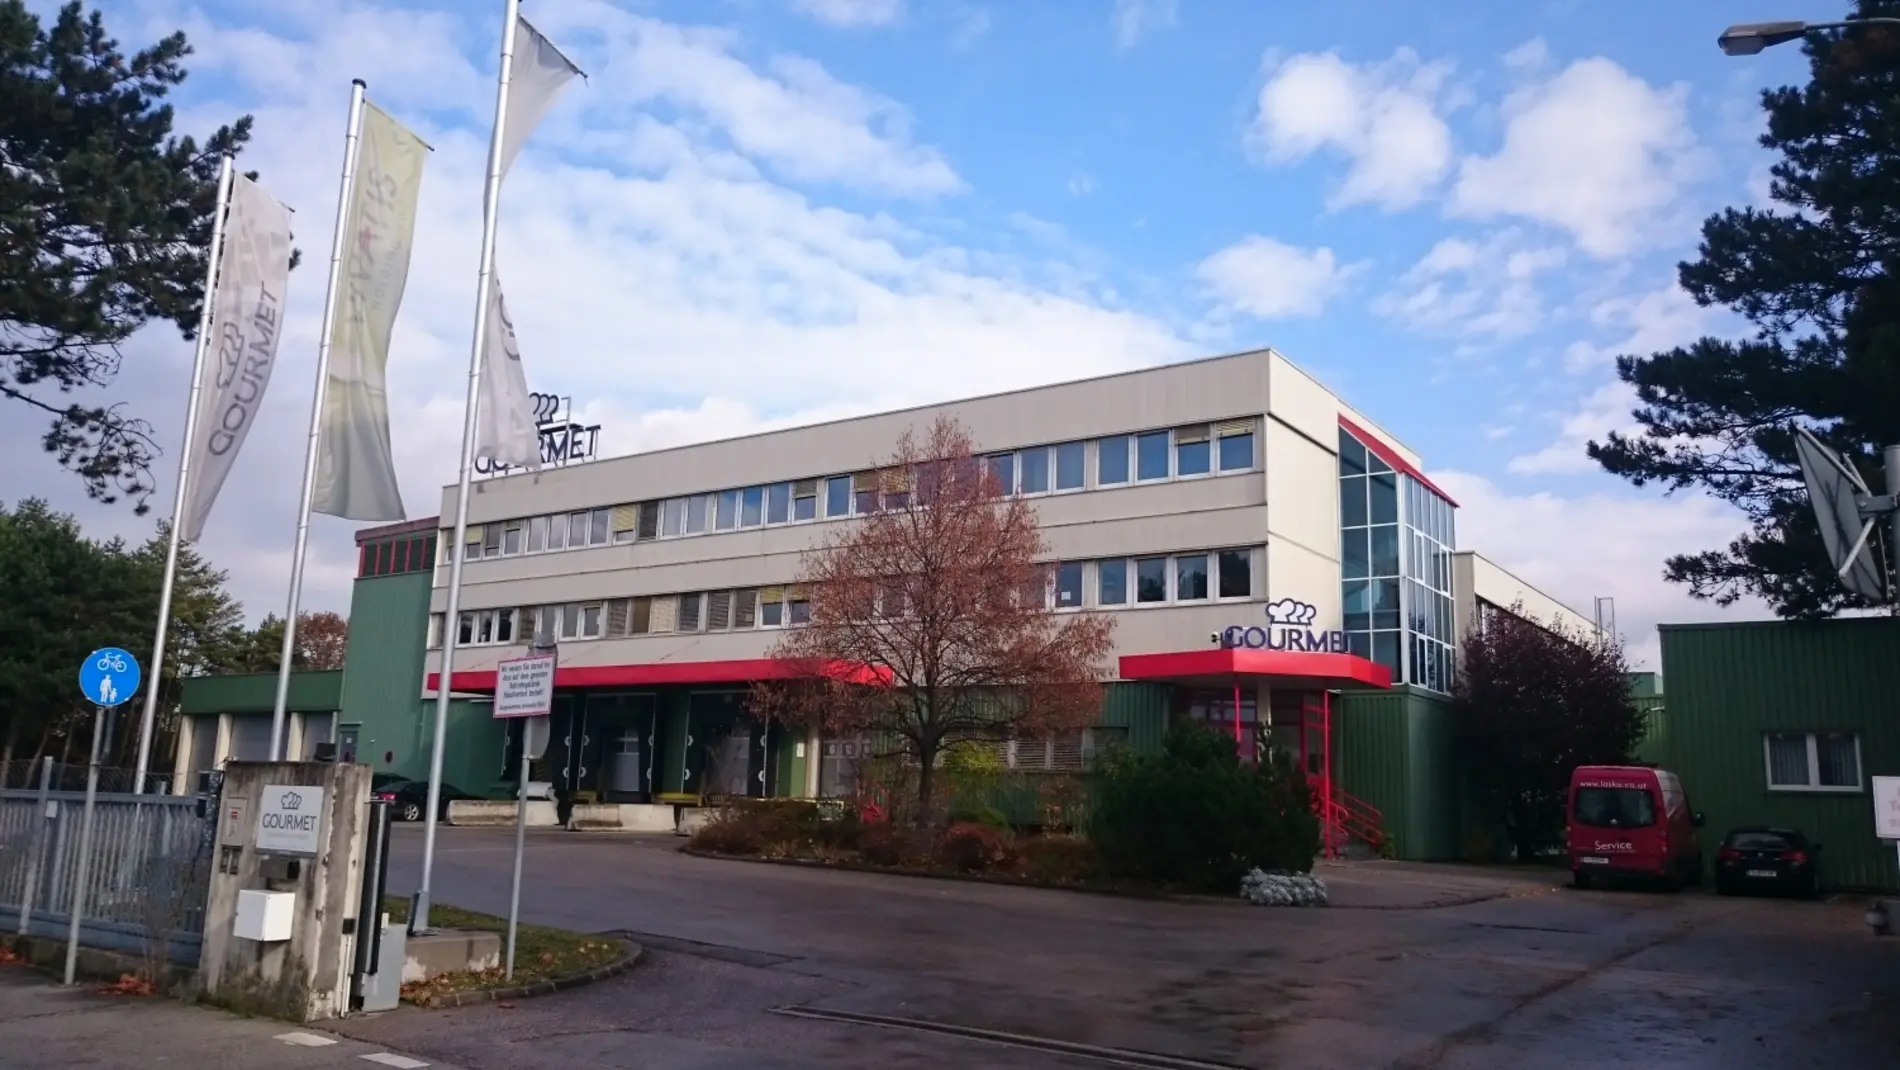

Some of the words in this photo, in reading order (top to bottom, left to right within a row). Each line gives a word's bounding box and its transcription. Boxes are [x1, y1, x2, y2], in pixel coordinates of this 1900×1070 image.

[208, 280, 277, 456] GOURMET
[261, 813, 317, 831] GOURMET
[1594, 840, 1632, 850] Service
